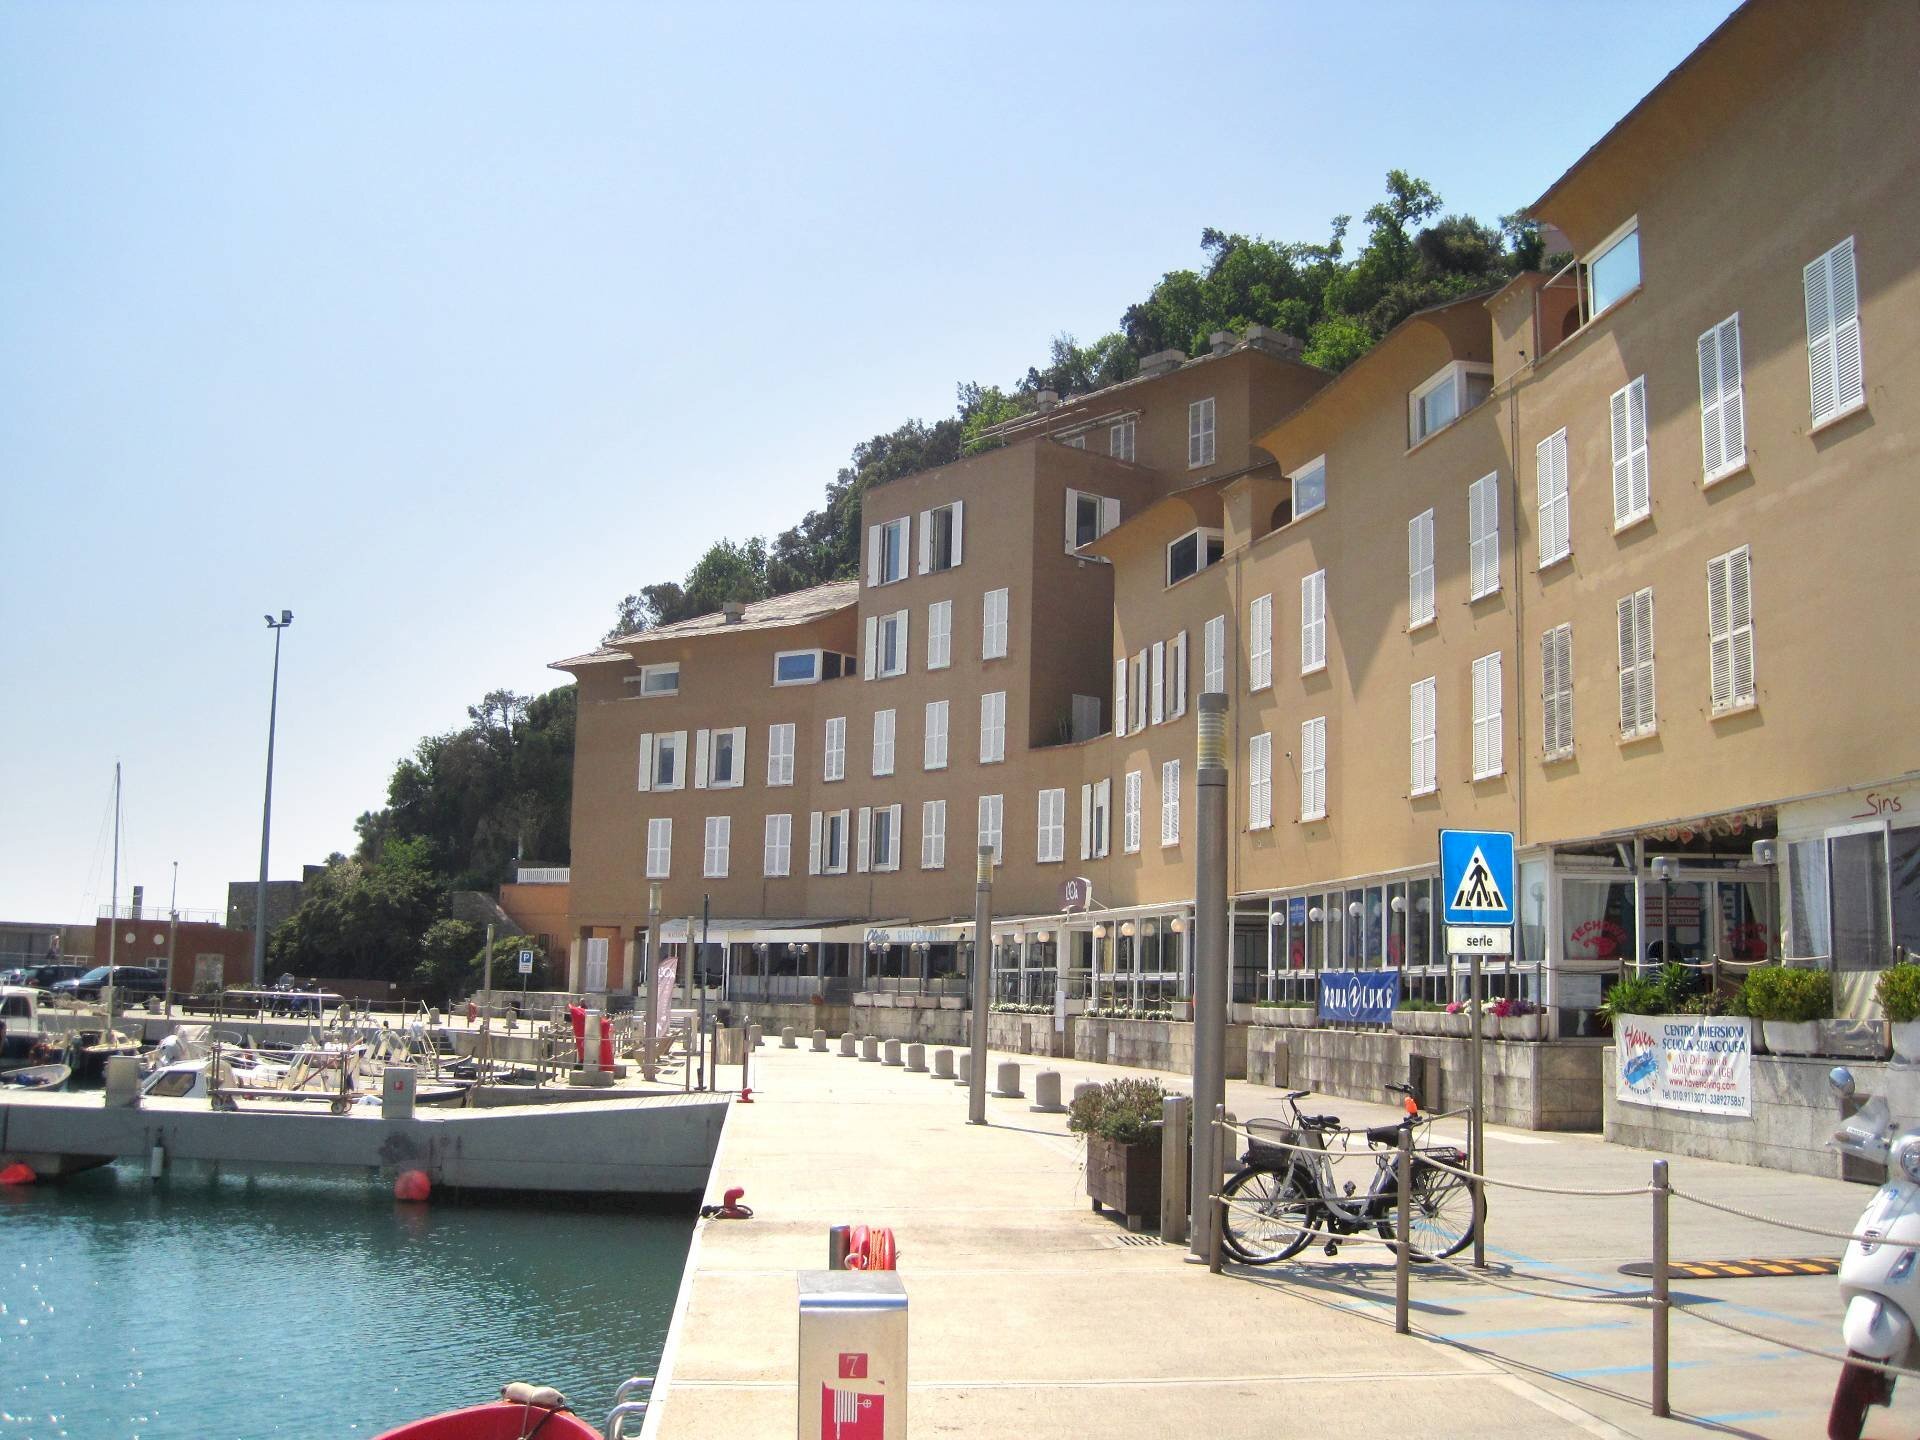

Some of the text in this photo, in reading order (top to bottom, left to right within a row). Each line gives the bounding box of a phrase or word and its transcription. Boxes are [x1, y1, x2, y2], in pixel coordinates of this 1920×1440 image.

[1850, 793, 1902, 819] Sins
[1466, 935, 1493, 947] serie
[1324, 985, 1393, 1009] AQUA LUNG
[1664, 1024, 1695, 1037] CENTRO
[1662, 1039, 1693, 1051] SCUOLA
[845, 1355, 859, 1377] 7
